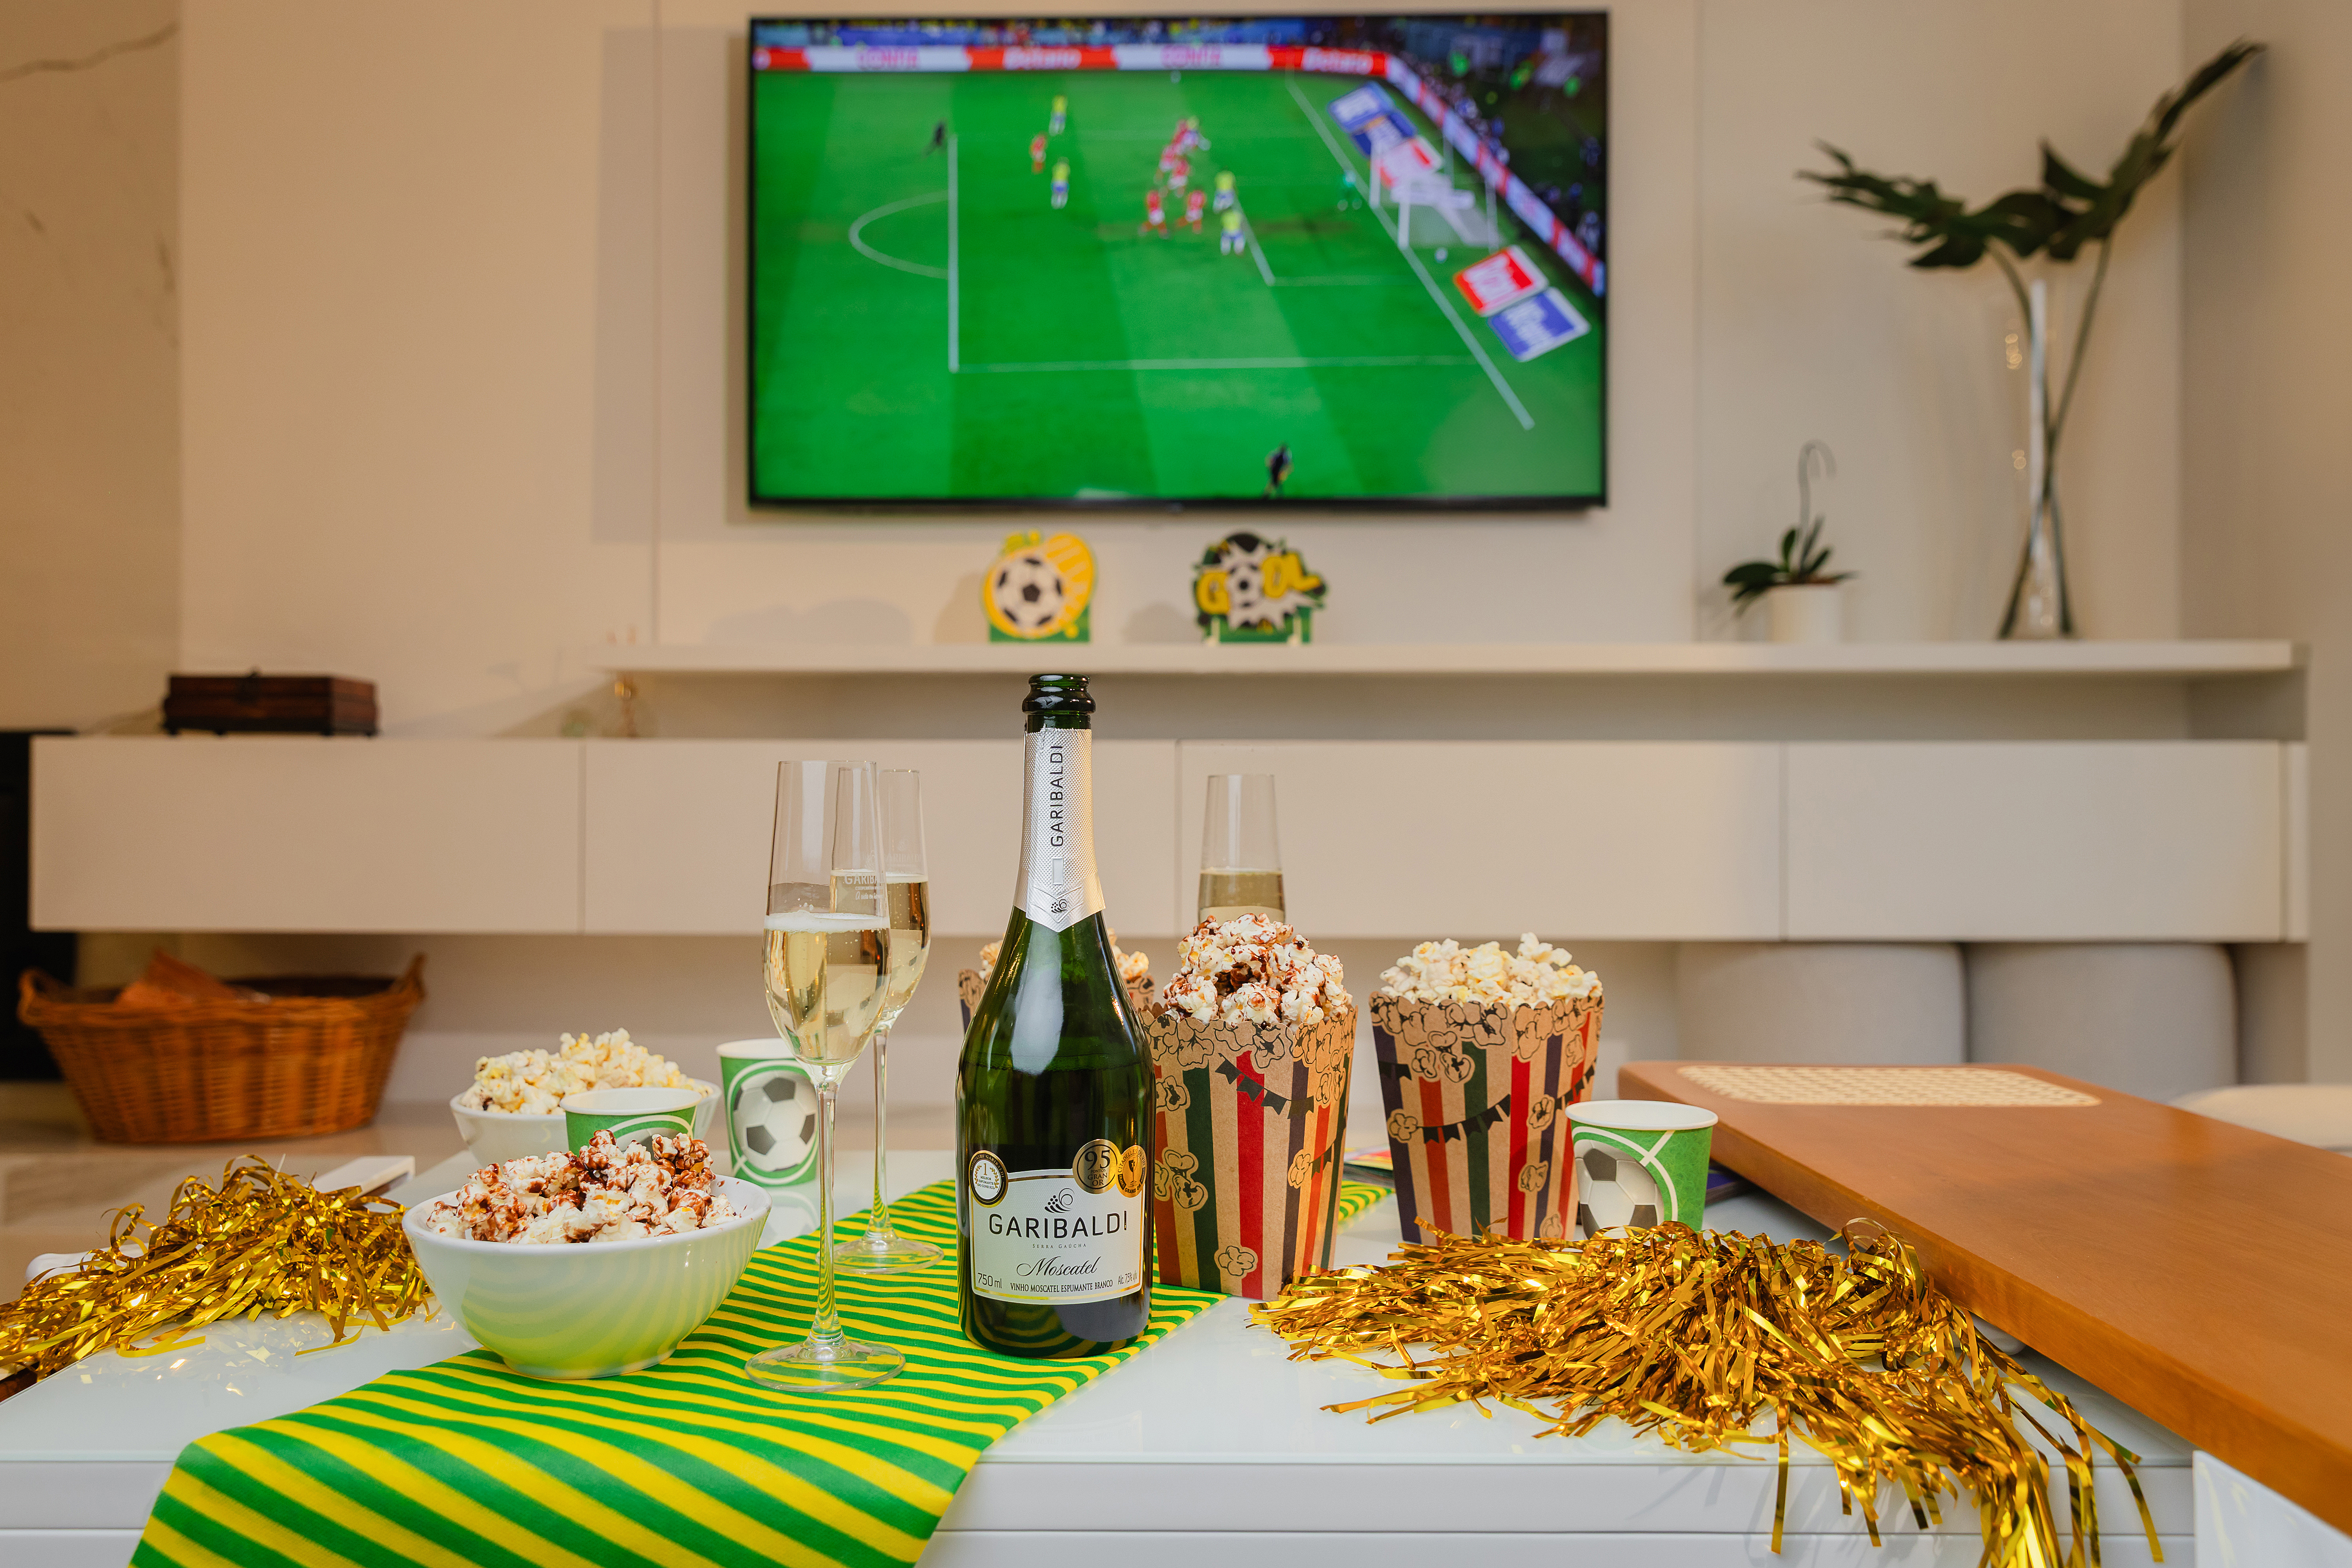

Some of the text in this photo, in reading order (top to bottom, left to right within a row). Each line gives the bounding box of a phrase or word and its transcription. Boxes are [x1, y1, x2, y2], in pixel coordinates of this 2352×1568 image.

[1050, 746, 1063, 846] GARIBALDI
[971, 1154, 1004, 1178] MOSCATEL GARIBALDI
[984, 1163, 987, 1175] 1
[1085, 1149, 1111, 1170] 95
[1118, 1149, 1137, 1172] CITADELLES
[989, 1210, 1127, 1239] GARIBALDI
[1016, 1256, 1102, 1276] Moscatel
[978, 1273, 1002, 1289] 750 ml
[1010, 1283, 1029, 1291] VINHO
[1061, 1283, 1093, 1292] ESPUMANTE
[1095, 1279, 1113, 1289] BRANCO
